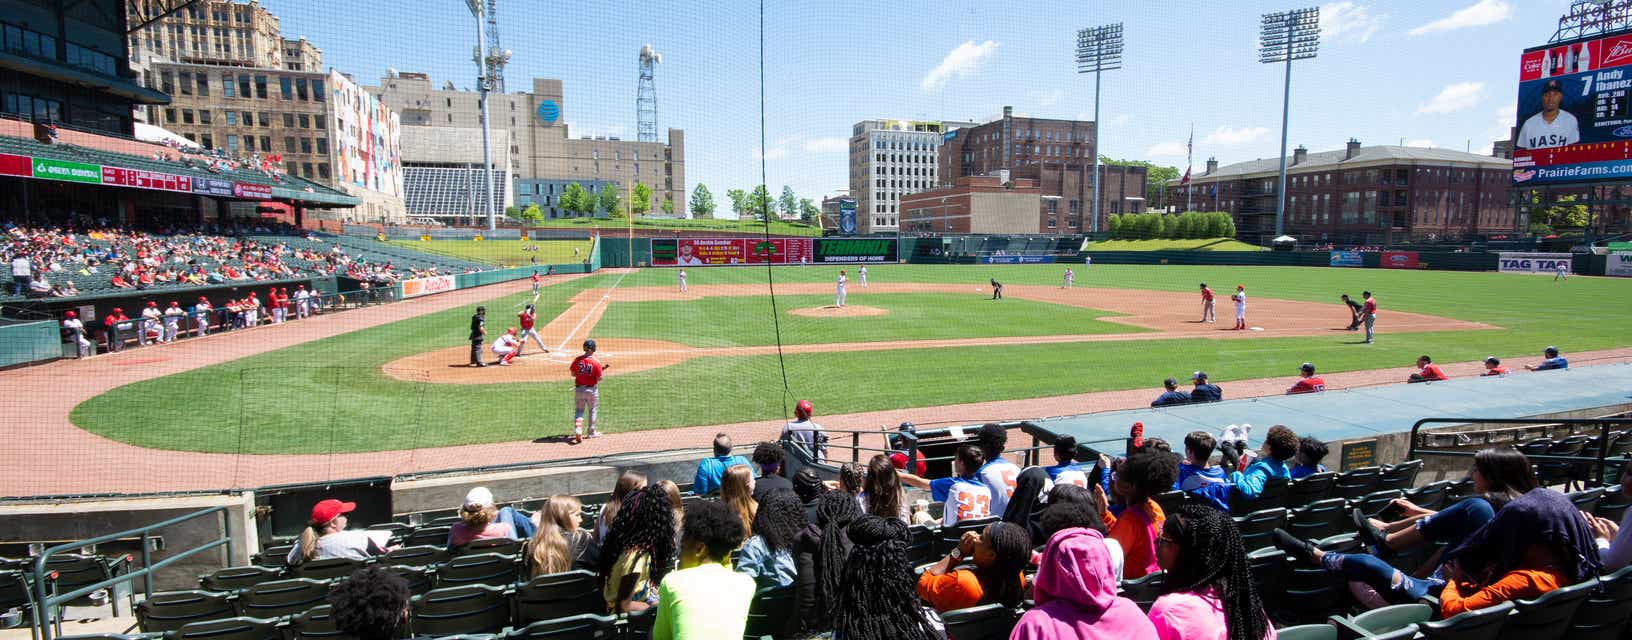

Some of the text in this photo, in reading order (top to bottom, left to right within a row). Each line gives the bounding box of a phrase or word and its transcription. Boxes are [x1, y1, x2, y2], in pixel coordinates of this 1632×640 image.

[1597, 70, 1623, 81] Andy
[1581, 76, 1593, 96] 7
[1596, 79, 1632, 91] Ibanez
[1530, 134, 1567, 148] NASH
[820, 240, 890, 255] TERMINIX
[1501, 260, 1531, 269] TAG
[578, 363, 593, 375] 24
[957, 491, 989, 521] 23
